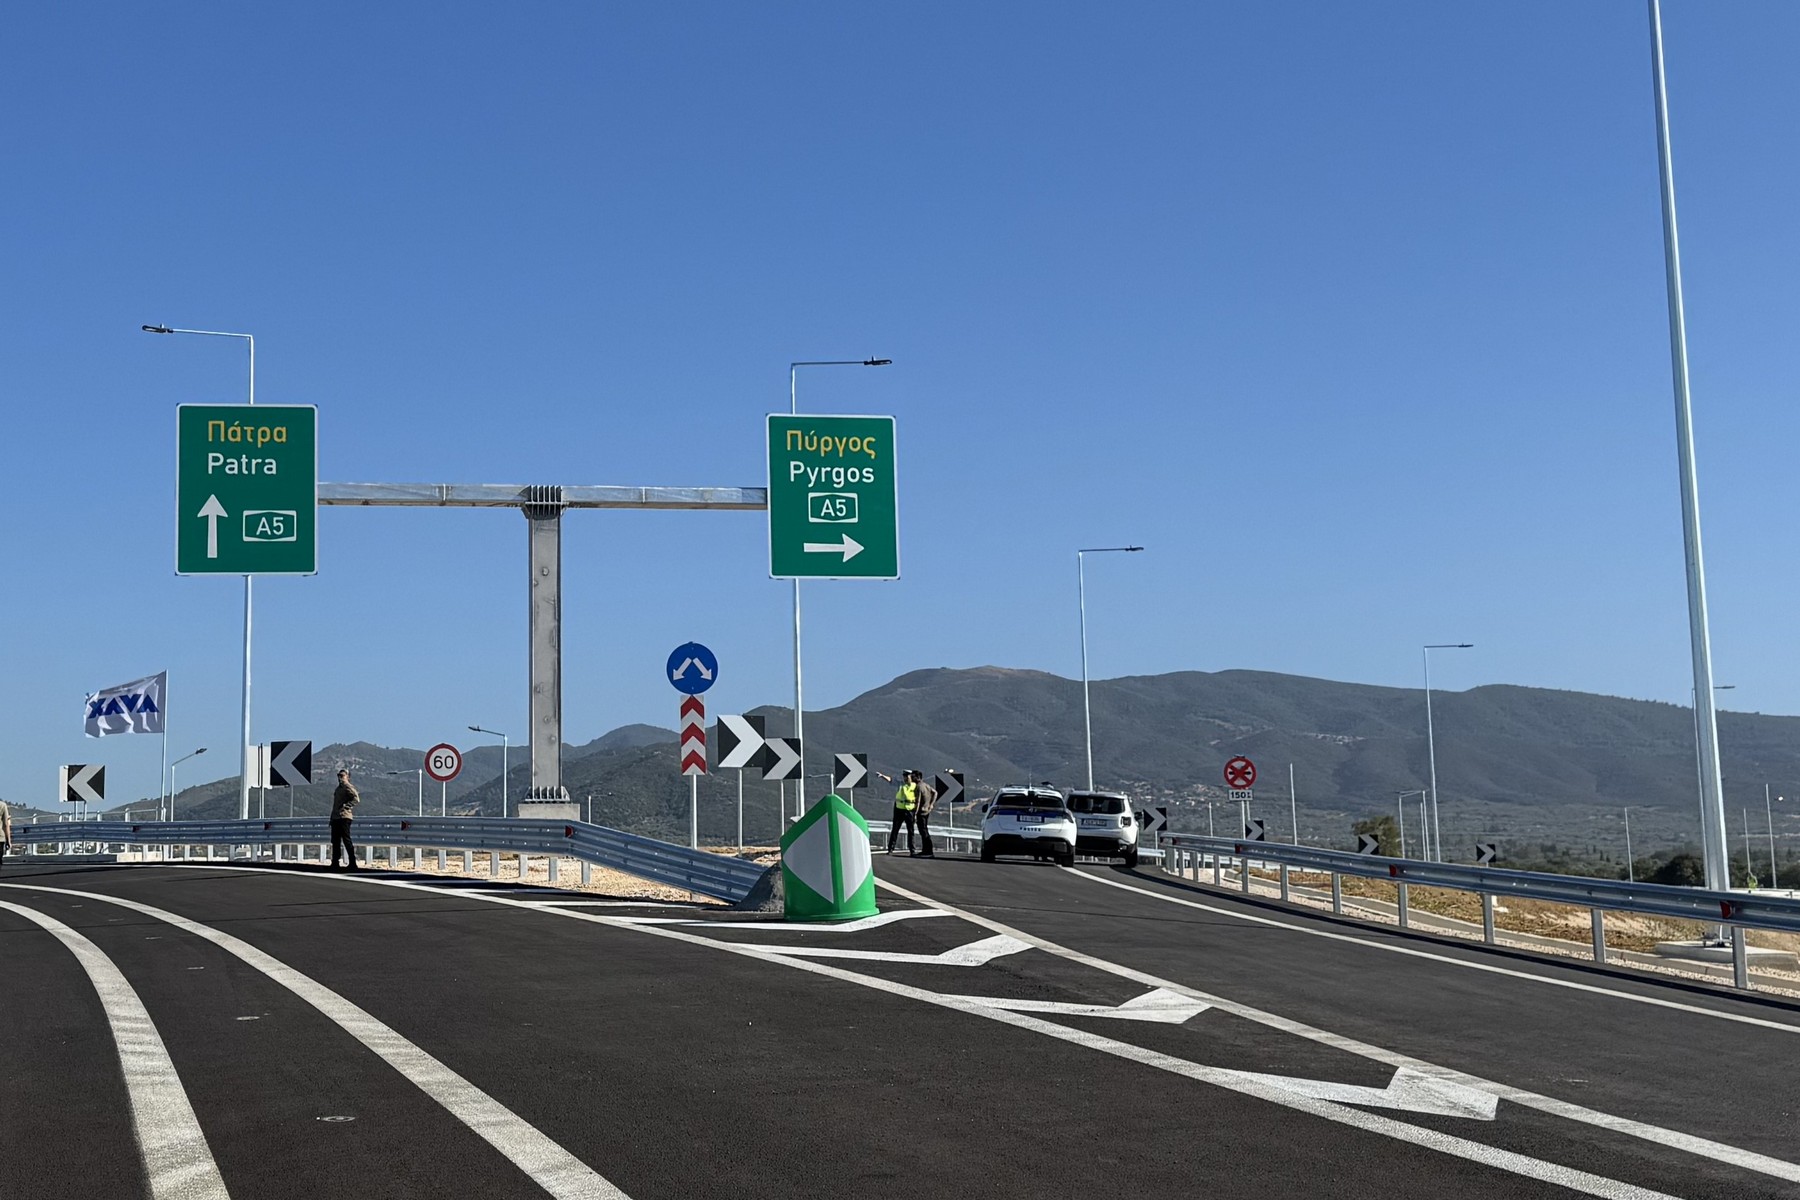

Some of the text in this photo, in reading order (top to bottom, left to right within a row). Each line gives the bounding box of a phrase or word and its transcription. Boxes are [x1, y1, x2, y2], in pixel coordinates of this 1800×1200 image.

[208, 420, 287, 448] Πάτρα
[786, 430, 876, 459] Πύργος
[207, 452, 277, 475] Patra
[790, 460, 875, 488] Pyrgos
[820, 498, 847, 517] A5
[255, 516, 284, 536] A5
[433, 755, 454, 769] 60
